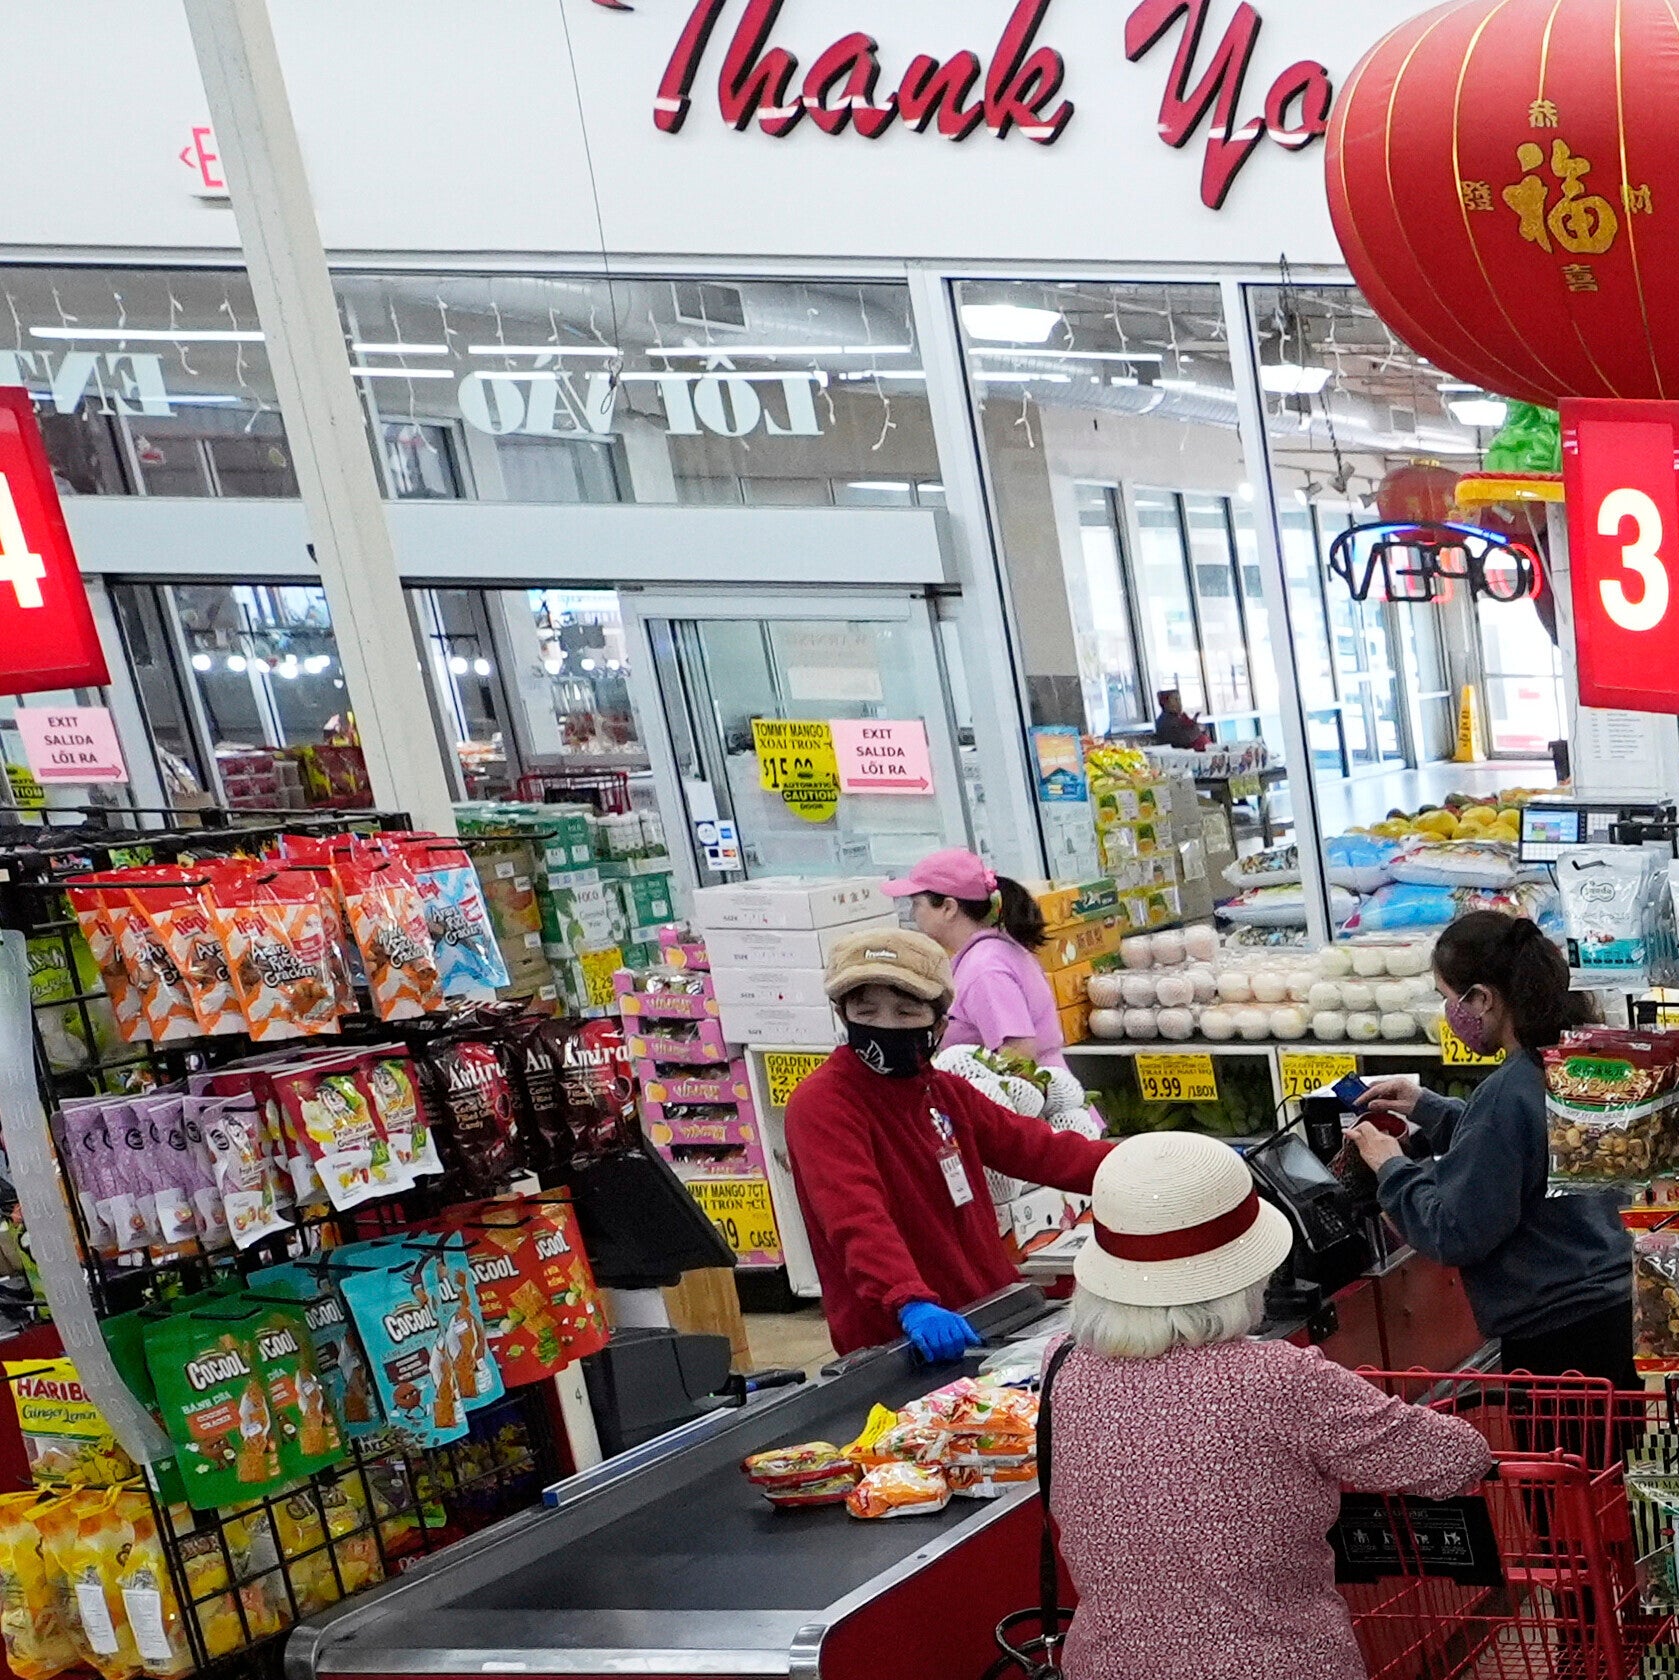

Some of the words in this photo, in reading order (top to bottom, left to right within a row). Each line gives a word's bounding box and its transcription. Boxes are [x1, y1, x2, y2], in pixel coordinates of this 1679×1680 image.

[1126, 0, 1334, 210] Yo
[1502, 139, 1618, 254] 福
[0, 472, 47, 609] 4
[1597, 488, 1671, 631] 3
[48, 717, 78, 727] EXIT
[756, 723, 787, 738] TOMMY
[789, 723, 824, 738] MANGO
[863, 728, 892, 739] EXIT
[44, 735, 94, 746] SALIDA
[80, 753, 98, 763] RA
[856, 747, 905, 757] SALIDA
[888, 764, 907, 775] RA
[783, 791, 837, 801] CAUTION
[562, 1037, 630, 1068] Amira
[767, 1056, 811, 1068] GOLDEN
[1144, 1077, 1182, 1098] $9.99
[711, 1184, 745, 1198] MANGO
[750, 1231, 778, 1249] CASE
[22, 1404, 64, 1421] Ginger
[63, 1408, 97, 1424] Lemon
